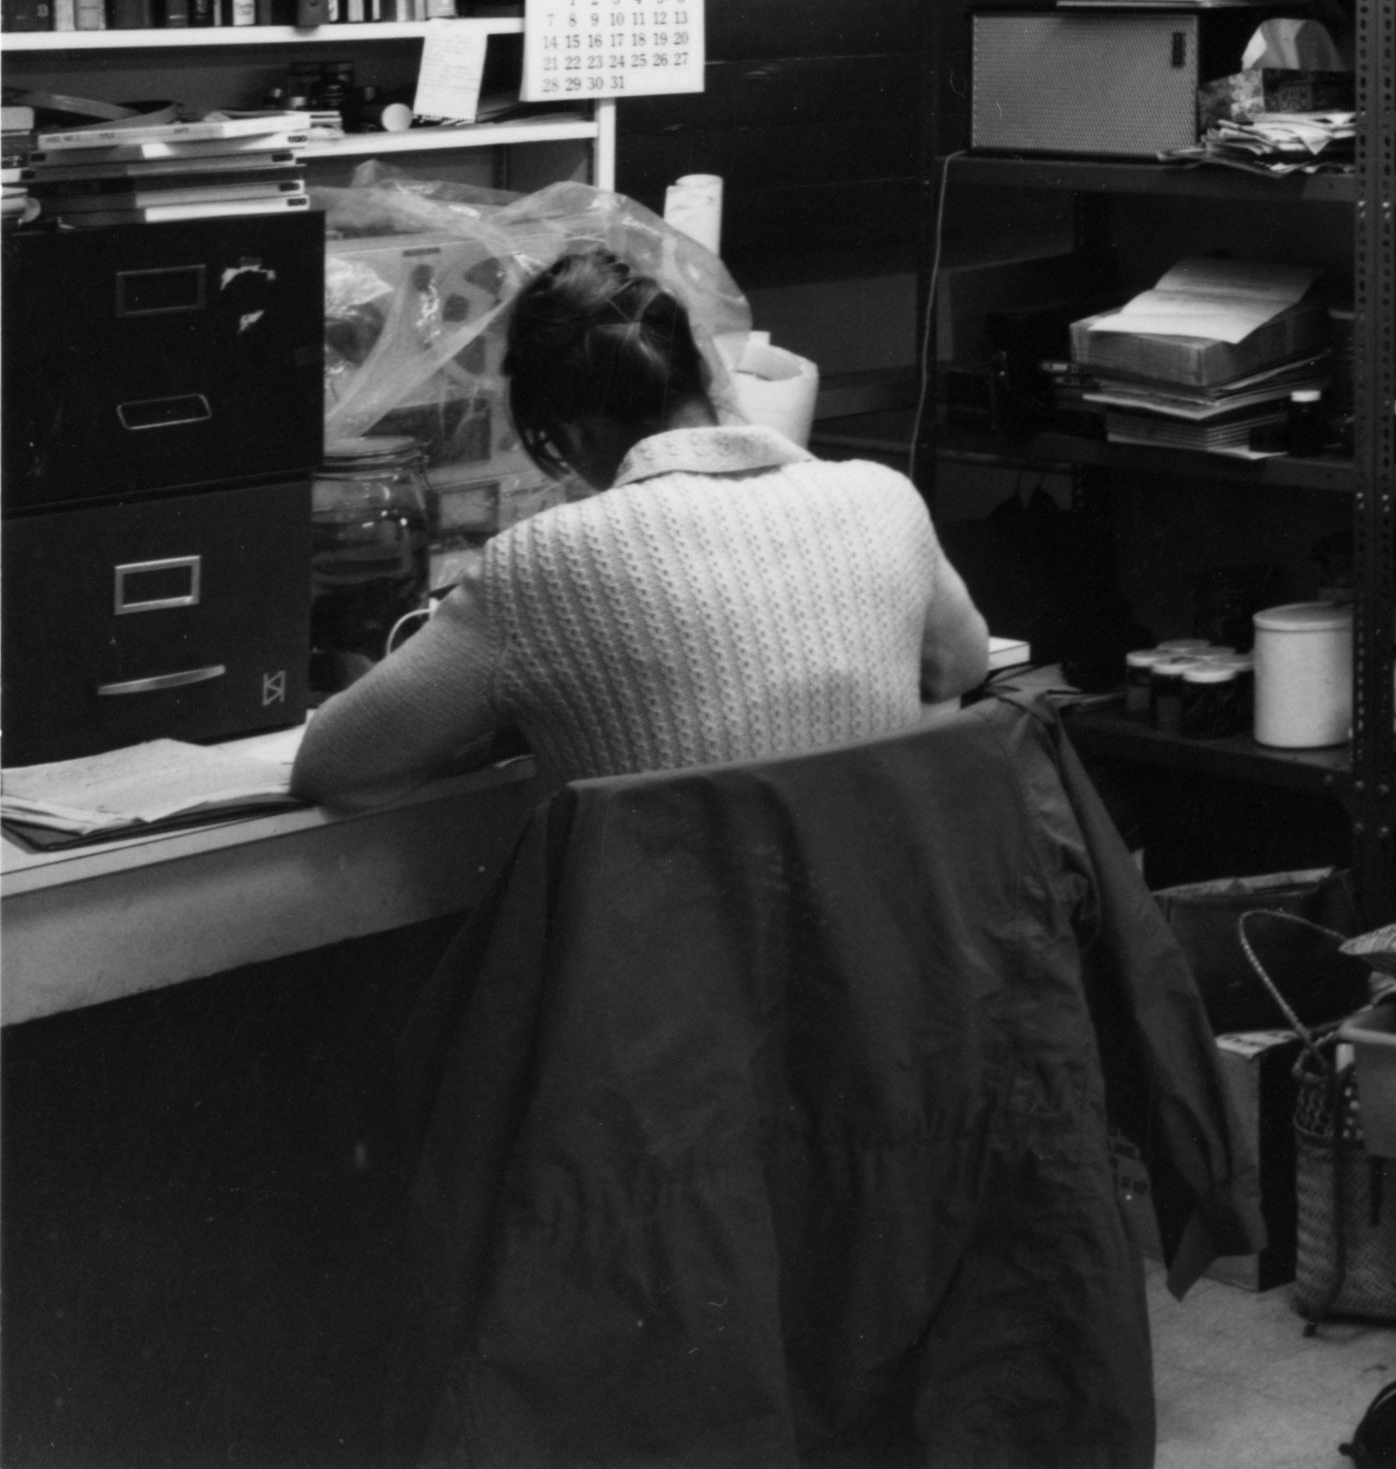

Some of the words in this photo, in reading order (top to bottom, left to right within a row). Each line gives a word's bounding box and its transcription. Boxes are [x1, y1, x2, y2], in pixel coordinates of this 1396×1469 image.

[547, 13, 554, 27] 7
[569, 13, 577, 27] 8
[591, 13, 599, 27] 9
[610, 12, 624, 26] 10
[632, 12, 646, 25] 11
[653, 12, 667, 25] 12
[674, 11, 688, 24] 13
[543, 35, 558, 49] 14
[566, 35, 580, 49] 15
[588, 34, 602, 48] 16
[610, 33, 624, 47] 17
[632, 33, 646, 46] 18
[653, 32, 668, 46] 19
[673, 32, 688, 45] 20
[543, 57, 558, 71] 21
[565, 56, 581, 70] 22
[587, 55, 603, 69] 23
[609, 54, 625, 68] 24
[631, 53, 647, 67] 25
[653, 53, 668, 67] 26
[674, 52, 688, 66] 27
[542, 78, 559, 92] 28
[565, 77, 581, 91] 29
[587, 77, 604, 90] 30
[610, 76, 624, 89] 31
